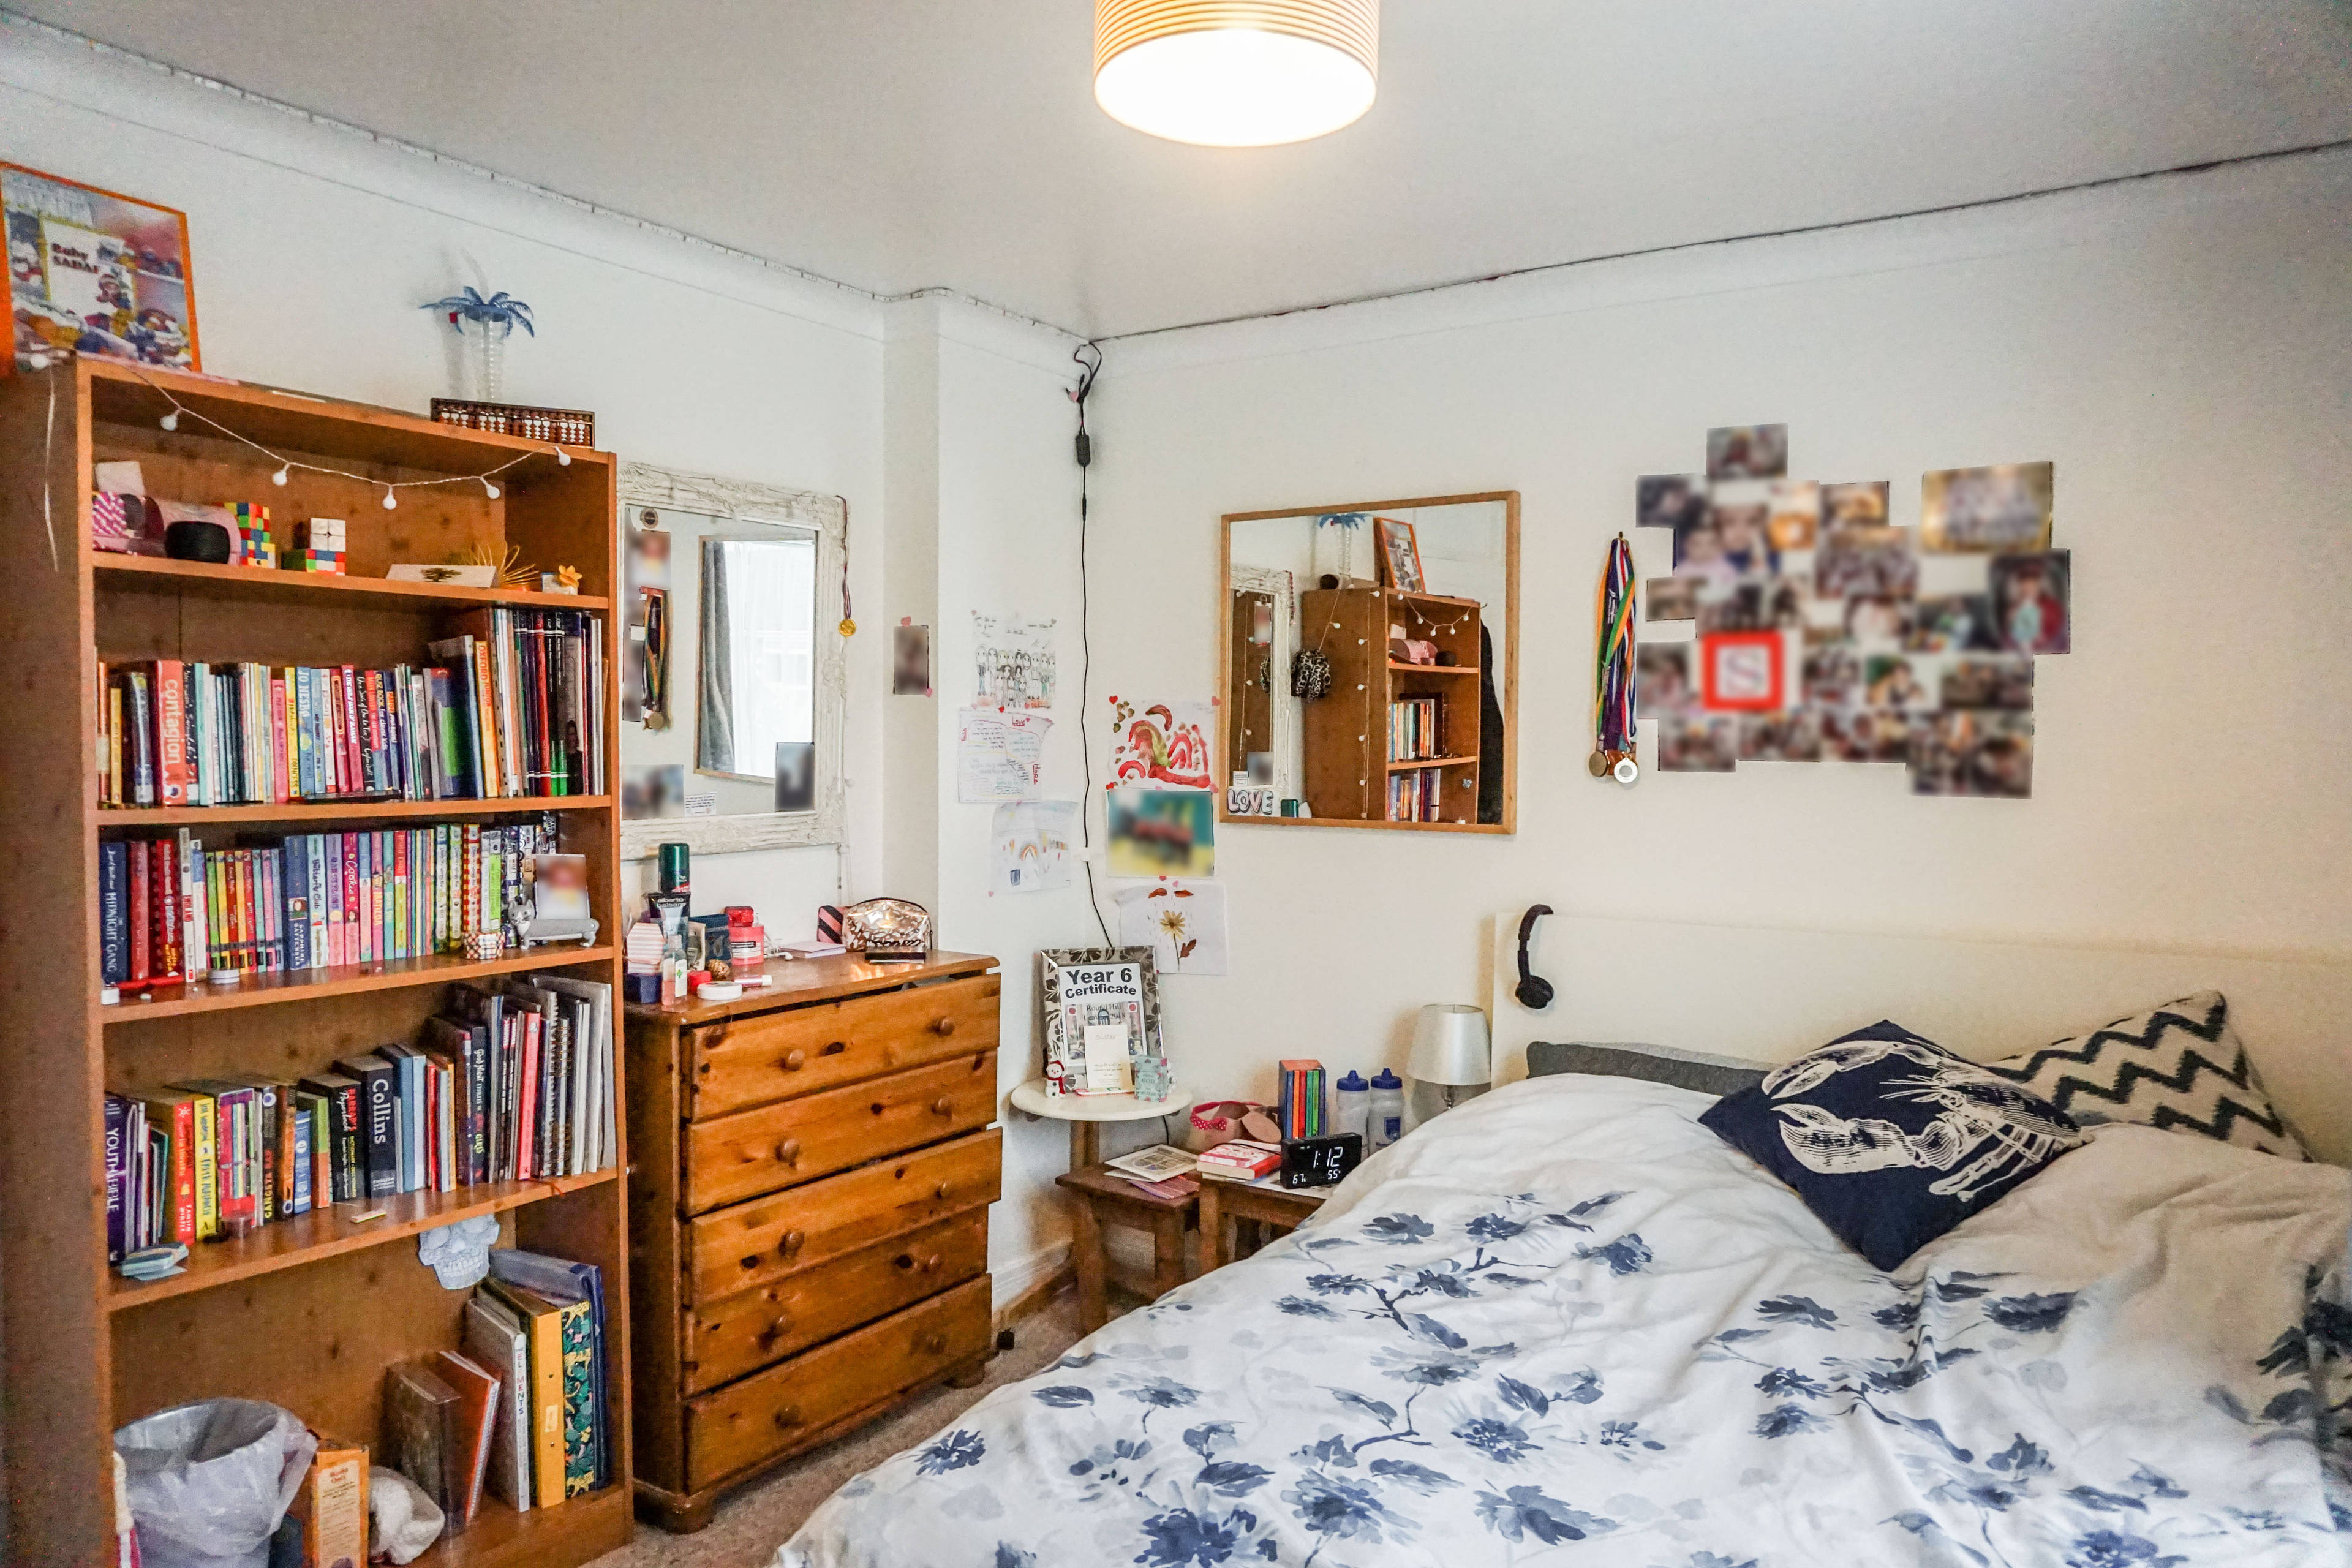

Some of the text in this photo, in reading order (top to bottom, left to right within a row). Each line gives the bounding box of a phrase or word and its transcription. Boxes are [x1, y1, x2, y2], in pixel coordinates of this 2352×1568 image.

[298, 671, 309, 682] JO
[478, 645, 488, 680] OXFORD
[165, 679, 184, 764] contagion
[1012, 715, 1025, 726] Love
[1227, 788, 1274, 815] LOVE
[312, 859, 321, 892] Butterfly
[346, 861, 358, 894] Cookie
[374, 891, 383, 926] MATILDA
[106, 892, 117, 972] MIDNIGHT GANG
[1065, 983, 1136, 998] Certificate
[1066, 968, 1132, 985] Year 6
[347, 1088, 357, 1132] HARRAP'S
[372, 1079, 391, 1144] Collins
[264, 1148, 273, 1169] RAP
[474, 1133, 484, 1154] GIRLS
[1313, 1147, 1343, 1169] 1:12
[106, 1128, 119, 1213] YOUTH BIBLE
[264, 1172, 273, 1219] GANGSTA
